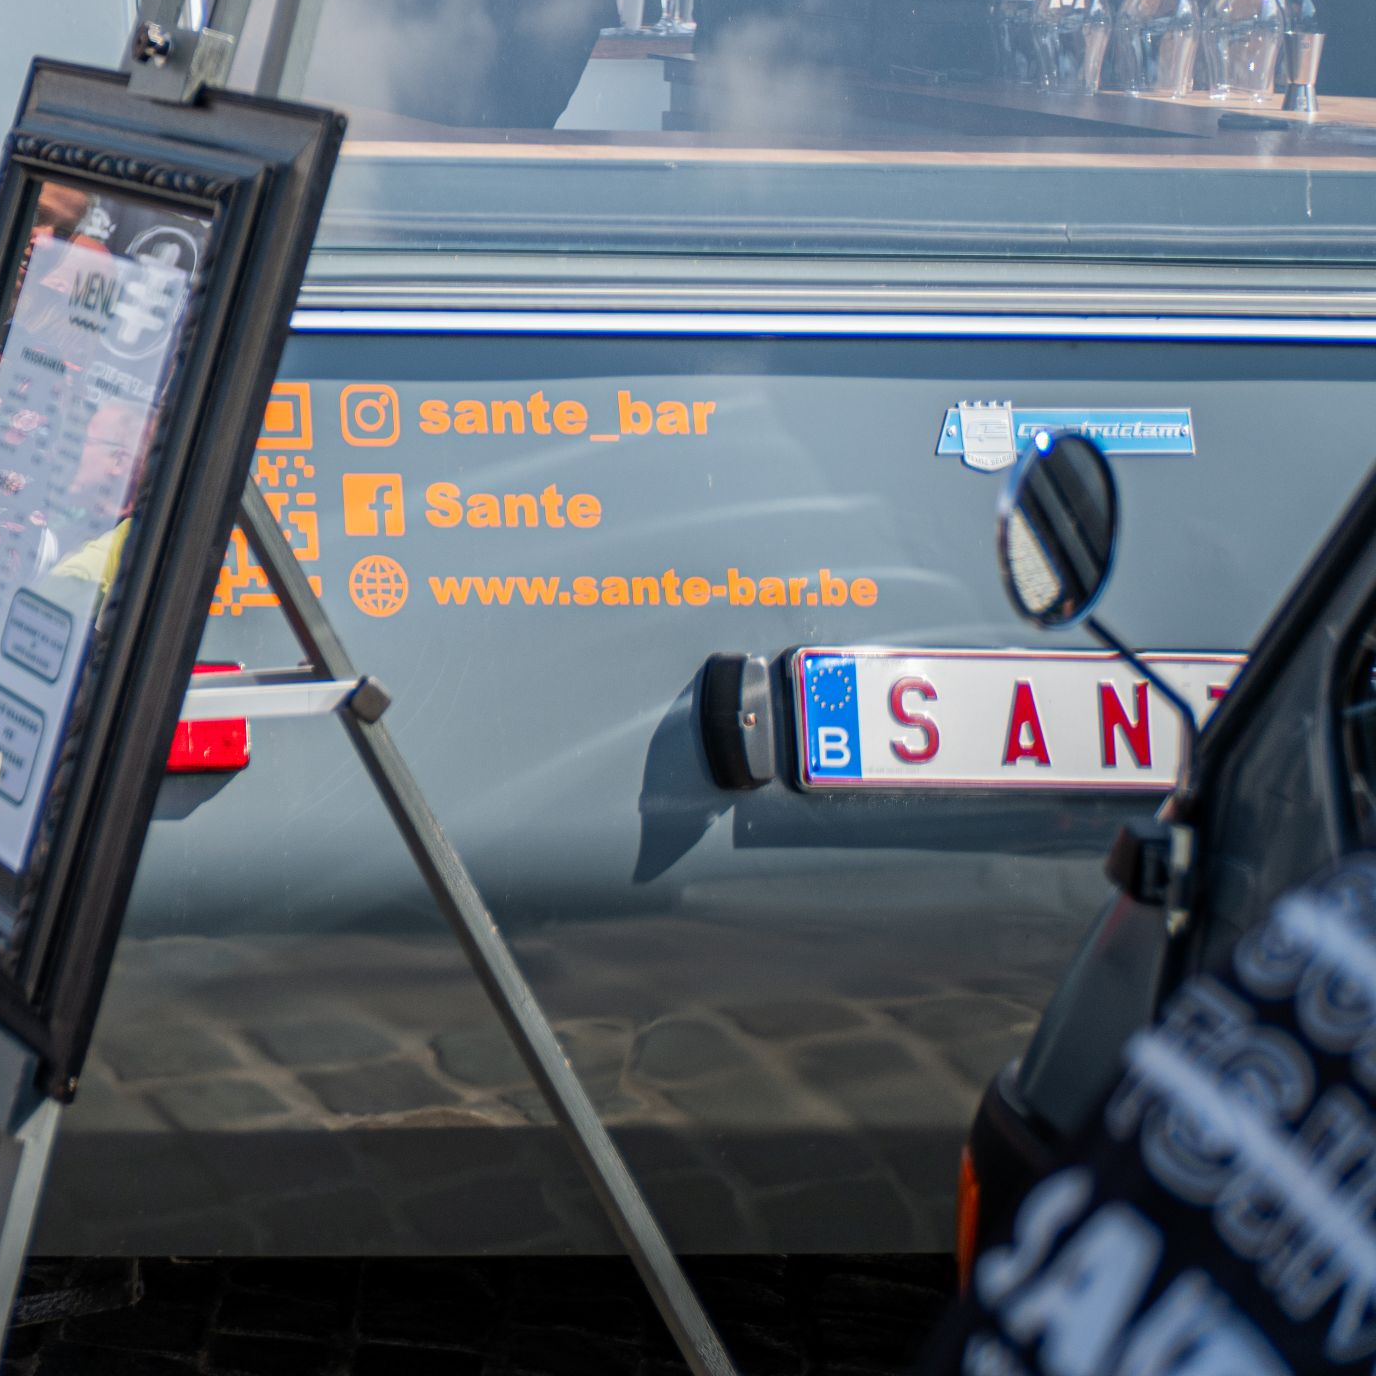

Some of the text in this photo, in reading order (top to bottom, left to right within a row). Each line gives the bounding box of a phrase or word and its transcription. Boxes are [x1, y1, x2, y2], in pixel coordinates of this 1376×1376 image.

[68, 272, 122, 320] MENU
[418, 390, 717, 442] sante_bar
[425, 481, 602, 528] Sante
[428, 568, 878, 607] www.sante-bar.be
[817, 675, 1230, 769] B SAN
